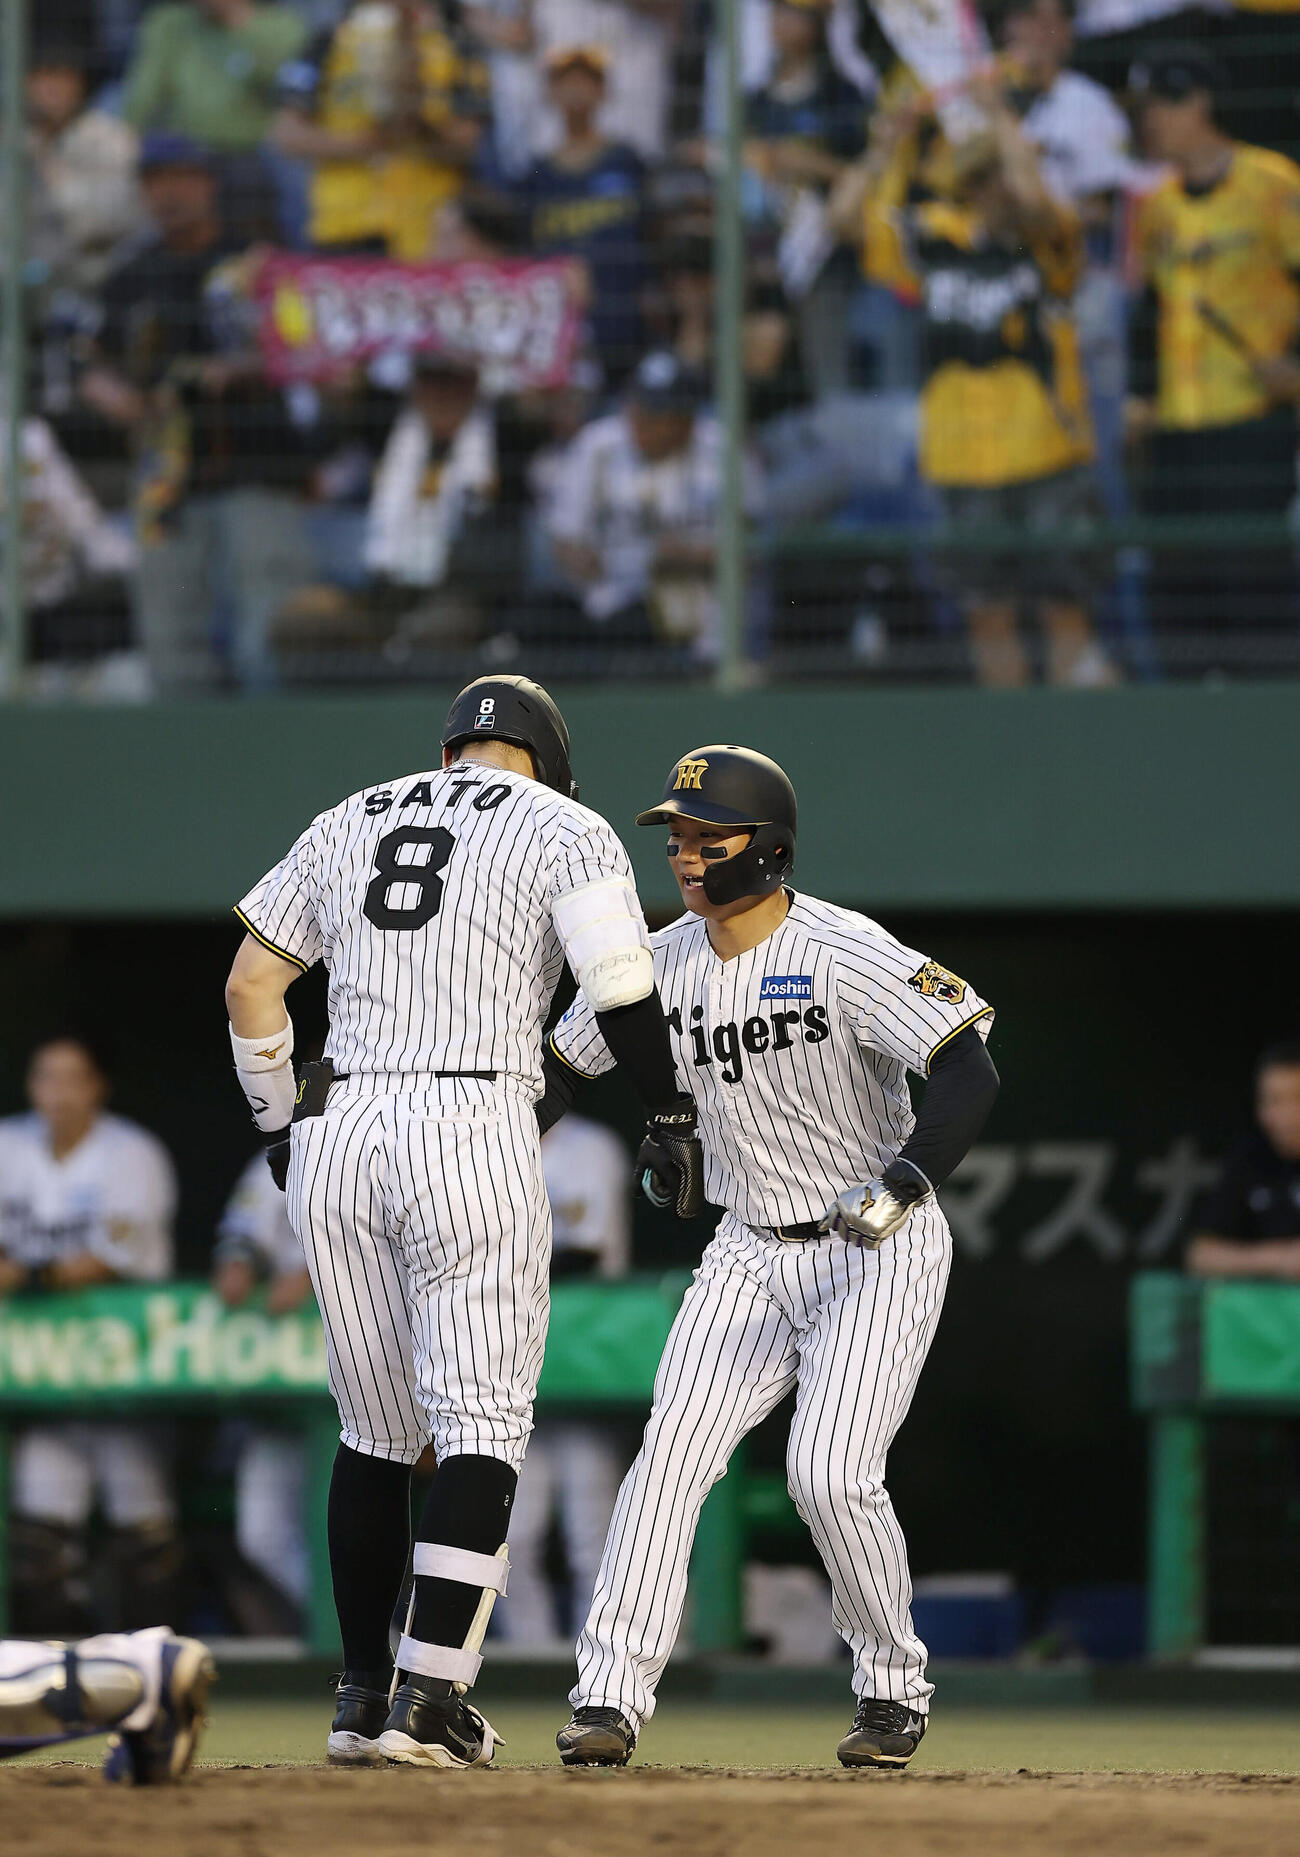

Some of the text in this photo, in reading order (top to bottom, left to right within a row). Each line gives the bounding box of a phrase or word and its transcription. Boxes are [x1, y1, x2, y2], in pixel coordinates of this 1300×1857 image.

[479, 698, 496, 715] 8
[365, 779, 513, 817] SATO
[362, 825, 457, 931] 8
[761, 979, 812, 996] Joshin
